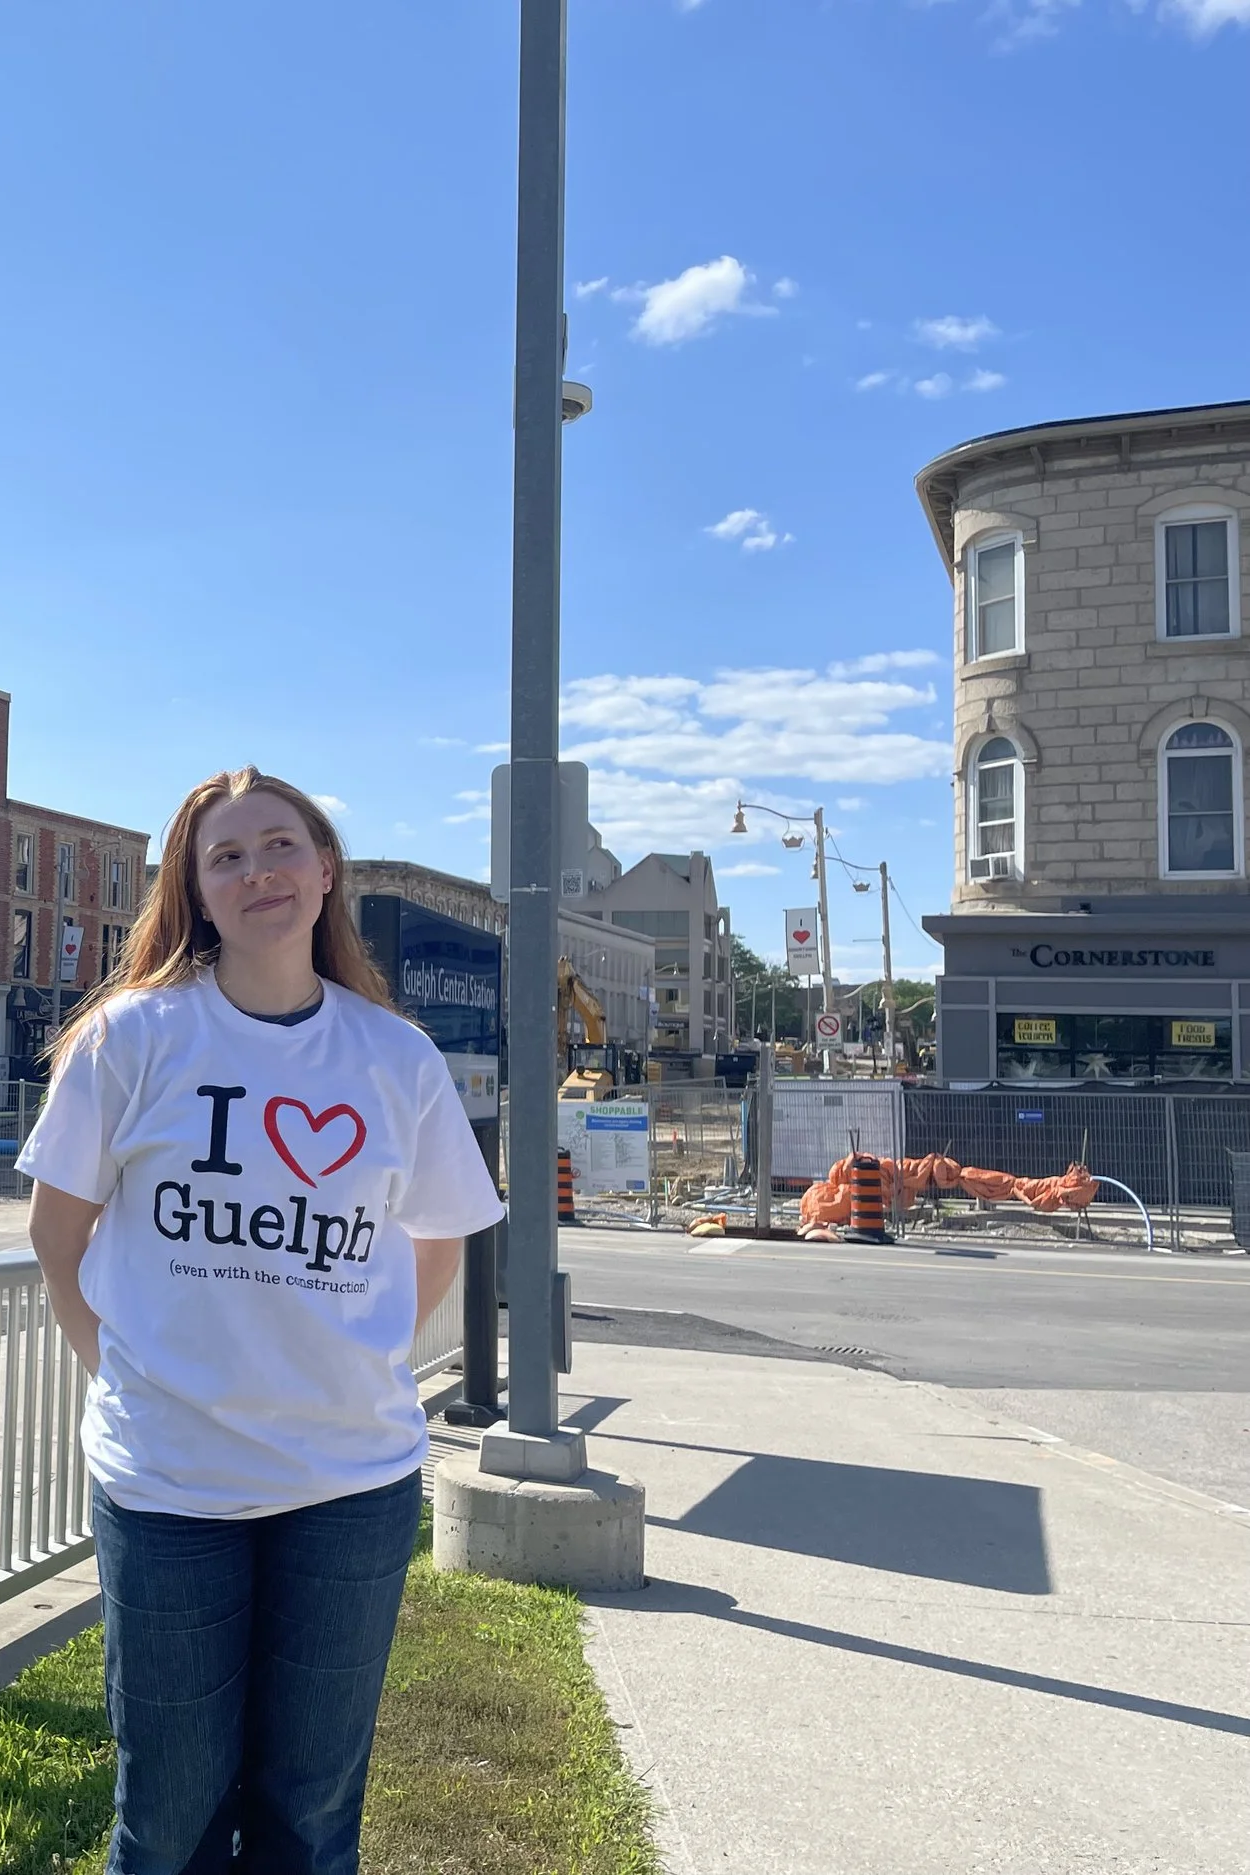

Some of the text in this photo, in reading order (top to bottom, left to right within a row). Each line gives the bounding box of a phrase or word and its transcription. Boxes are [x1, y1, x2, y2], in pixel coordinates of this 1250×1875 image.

[1029, 944, 1216, 968] CORNERSTONE
[403, 958, 496, 1010] Guelph Central Station
[191, 1084, 247, 1176] I
[590, 1105, 643, 1116] SHOPPABLE
[153, 1180, 376, 1273] Guelph
[169, 1257, 208, 1279] (even
[213, 1265, 251, 1281] with
[254, 1269, 281, 1285] the
